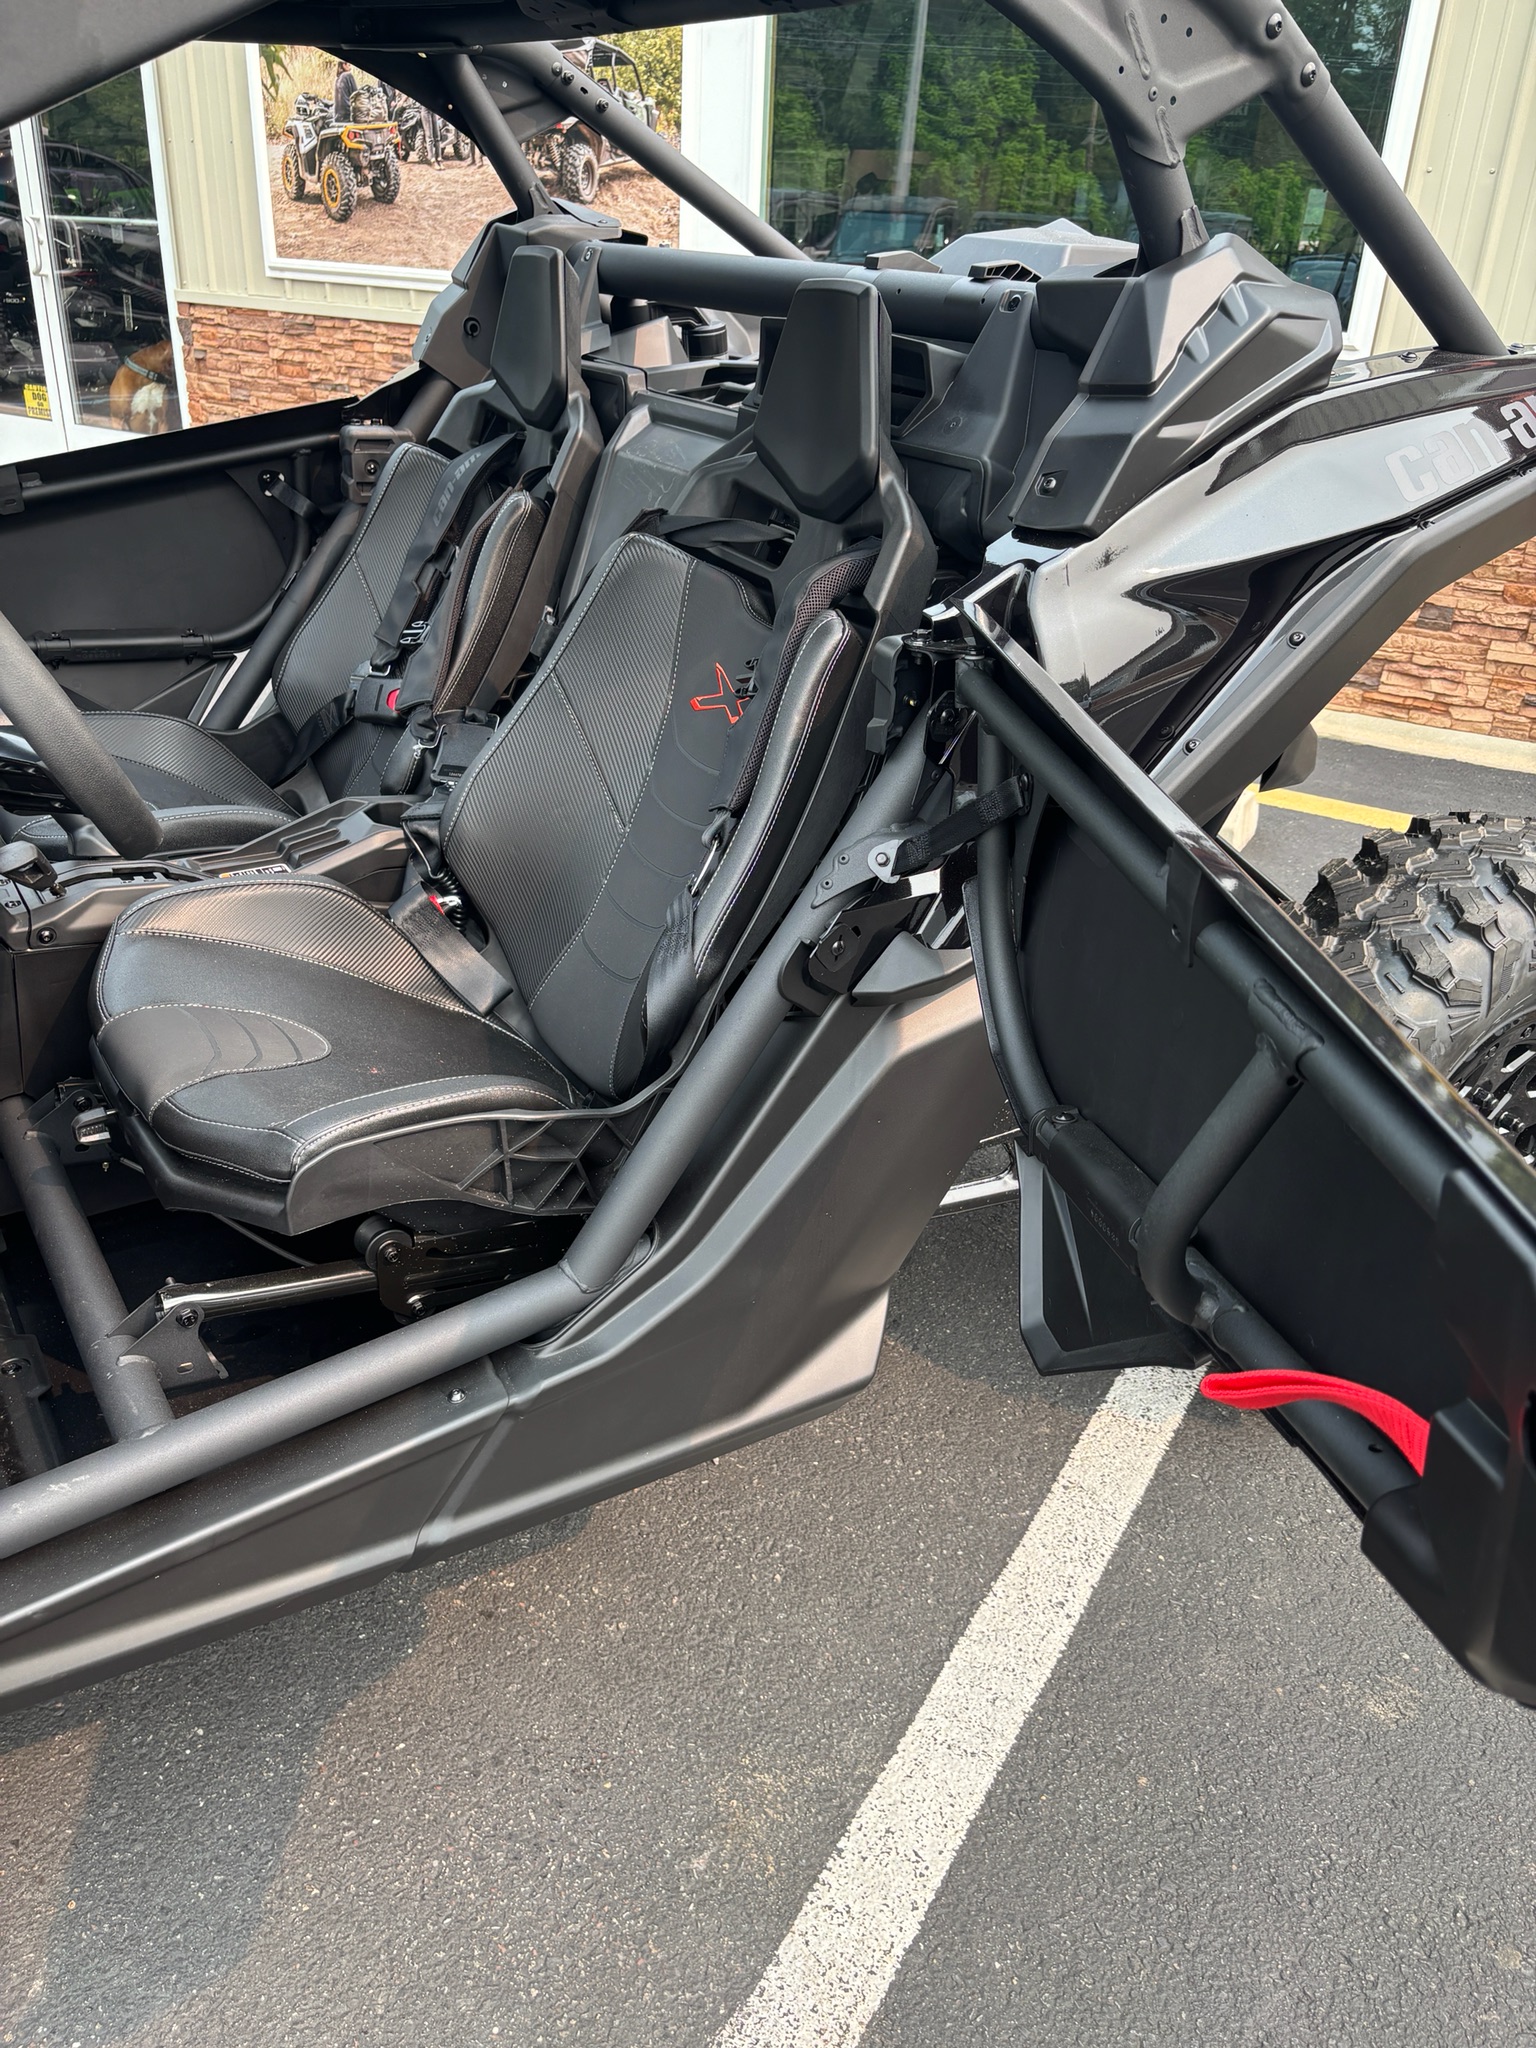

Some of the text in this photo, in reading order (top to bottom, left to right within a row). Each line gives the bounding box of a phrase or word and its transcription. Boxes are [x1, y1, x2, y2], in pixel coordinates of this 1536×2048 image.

[32, 392, 47, 402] DOG
[1384, 395, 1536, 502] can-a
[433, 452, 482, 527] can-am
